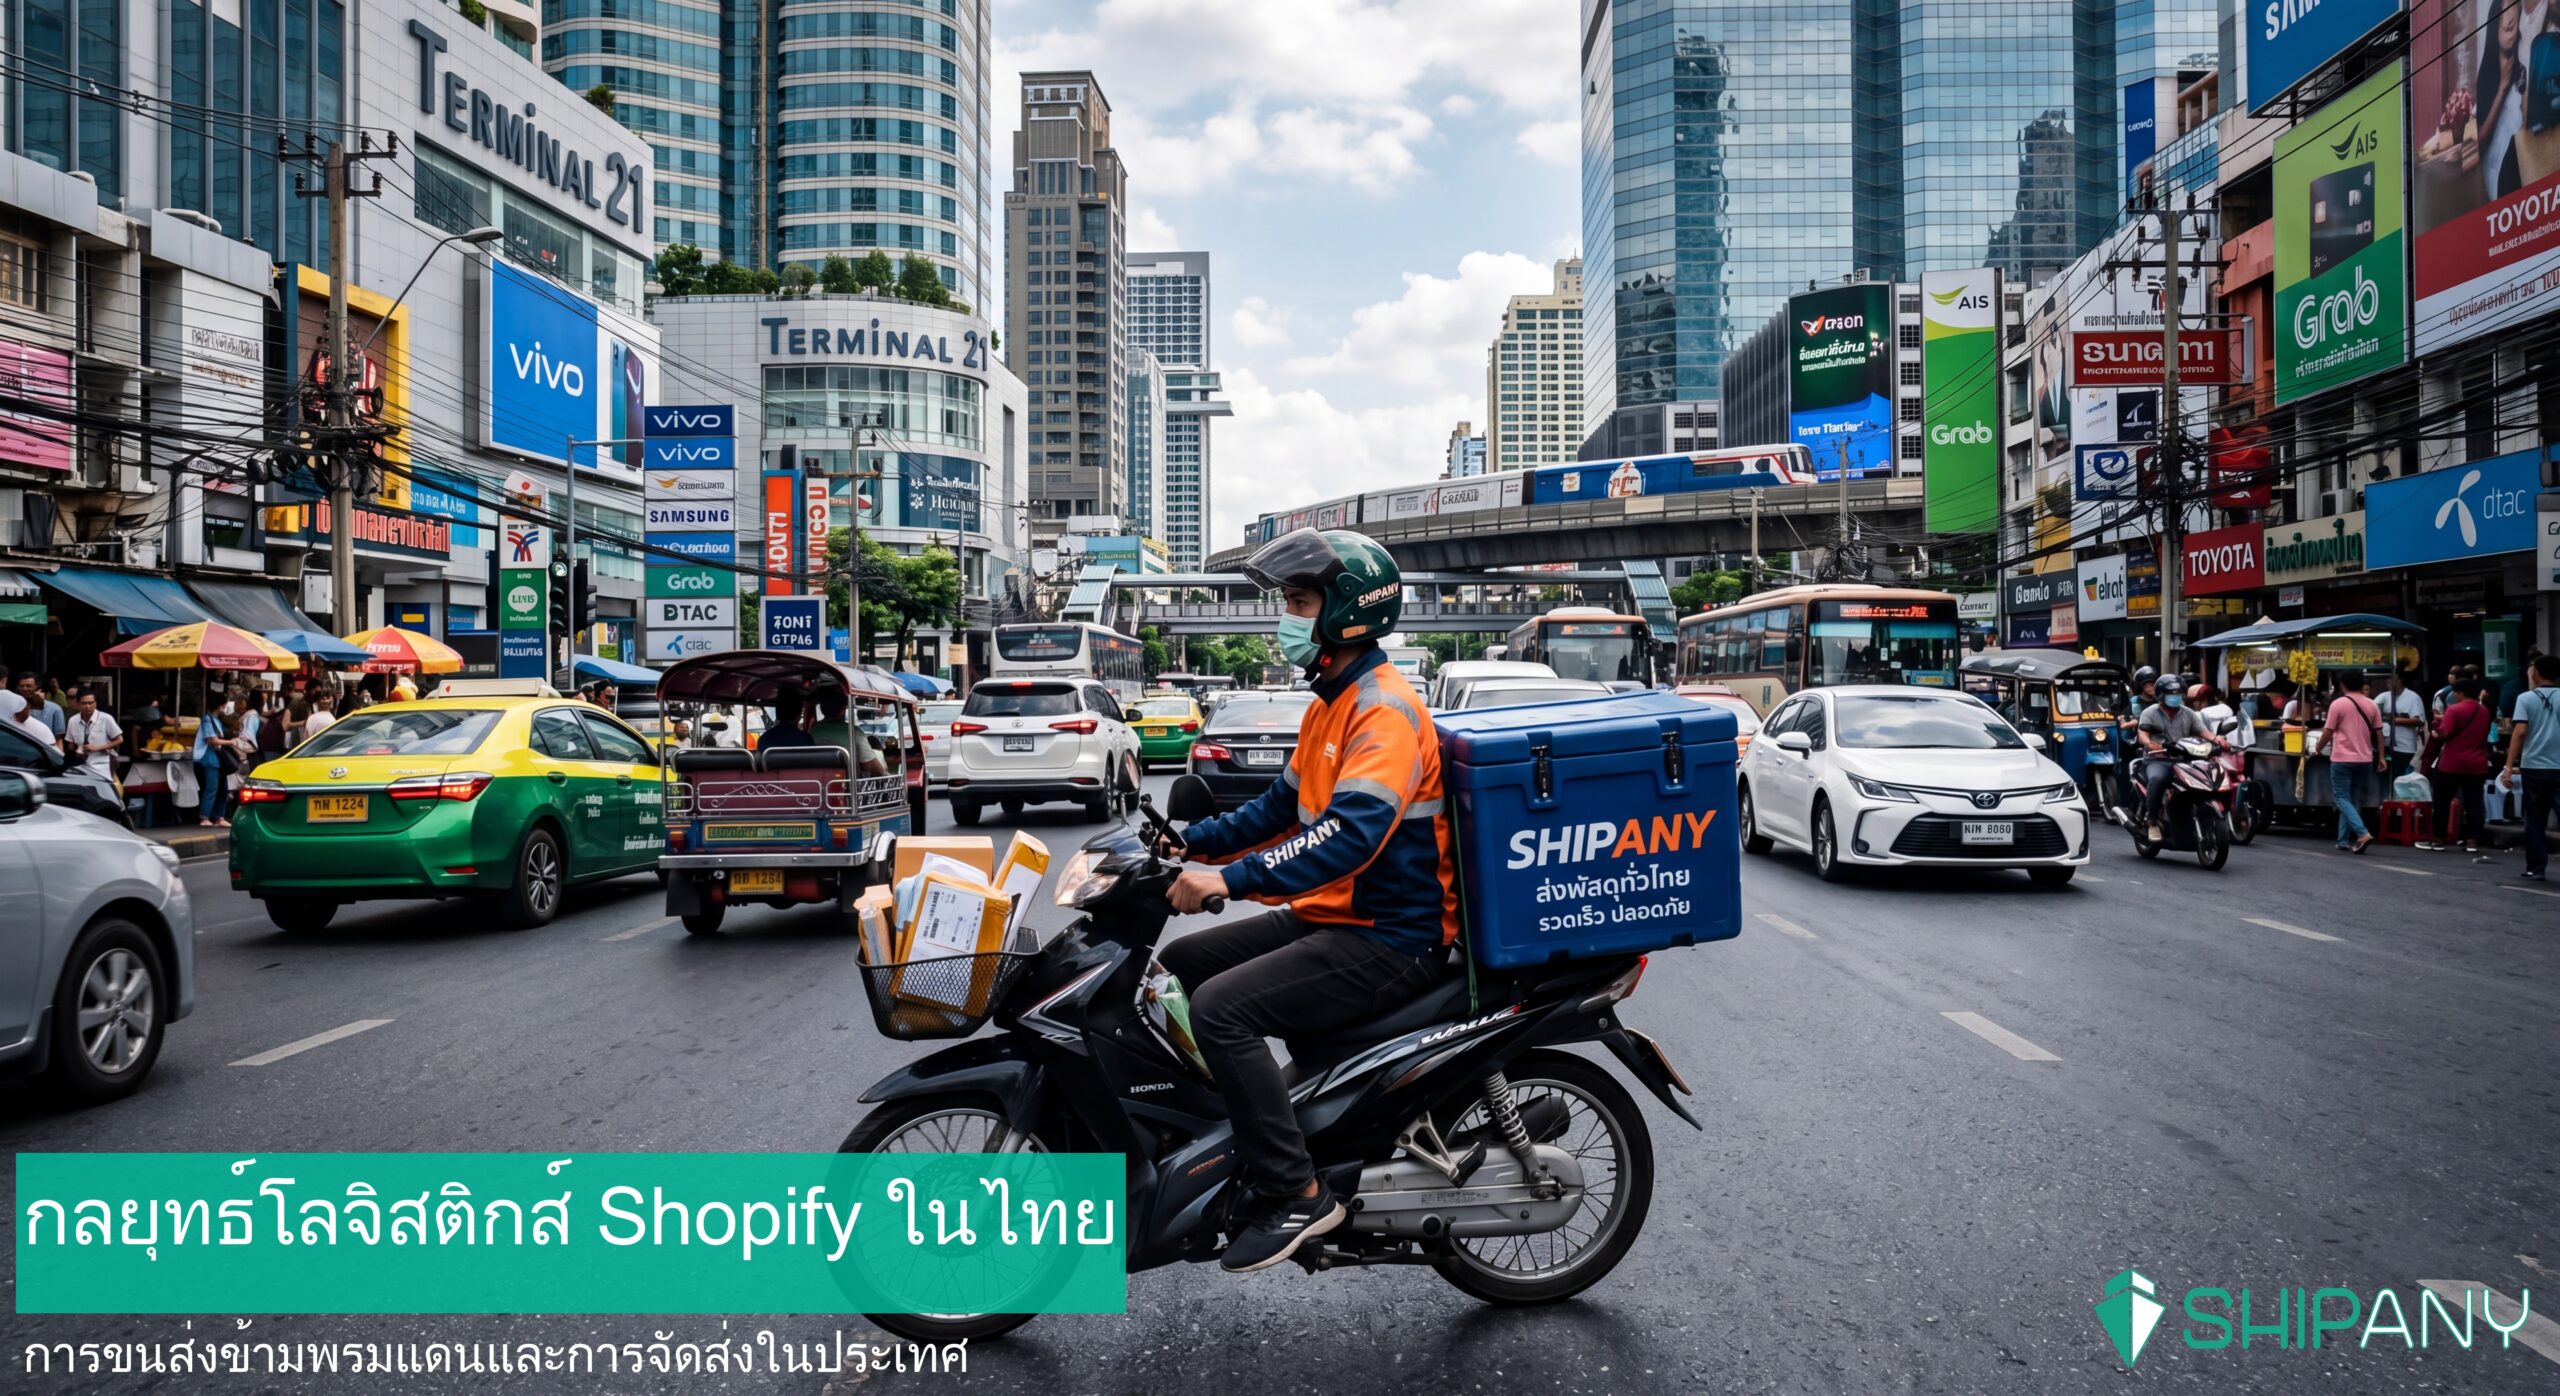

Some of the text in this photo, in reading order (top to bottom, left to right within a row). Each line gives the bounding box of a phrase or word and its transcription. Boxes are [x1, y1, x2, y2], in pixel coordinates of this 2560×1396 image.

[2355, 129, 2378, 160] AIS
[606, 151, 646, 234] 21
[1958, 295, 1990, 310] AIS
[2294, 264, 2379, 349] Grab
[963, 329, 988, 372] 21
[509, 340, 584, 397] vivo
[653, 410, 722, 429] vivo
[1931, 420, 1993, 445] Grab
[657, 443, 721, 461] vivo
[650, 509, 730, 523] SAMSUNG
[2483, 486, 2526, 520] dtac
[2188, 541, 2255, 577] TOYOTA
[667, 571, 715, 590] Grab
[1263, 817, 1342, 870] SHIPANY
[1506, 808, 1719, 871] SHIPANY
[1535, 862, 1691, 904] ส่งพัสดุทั่วไทย
[1538, 896, 1691, 932] รวดเร็ว ปลอดภัย
[1130, 1082, 1176, 1094] HONDA
